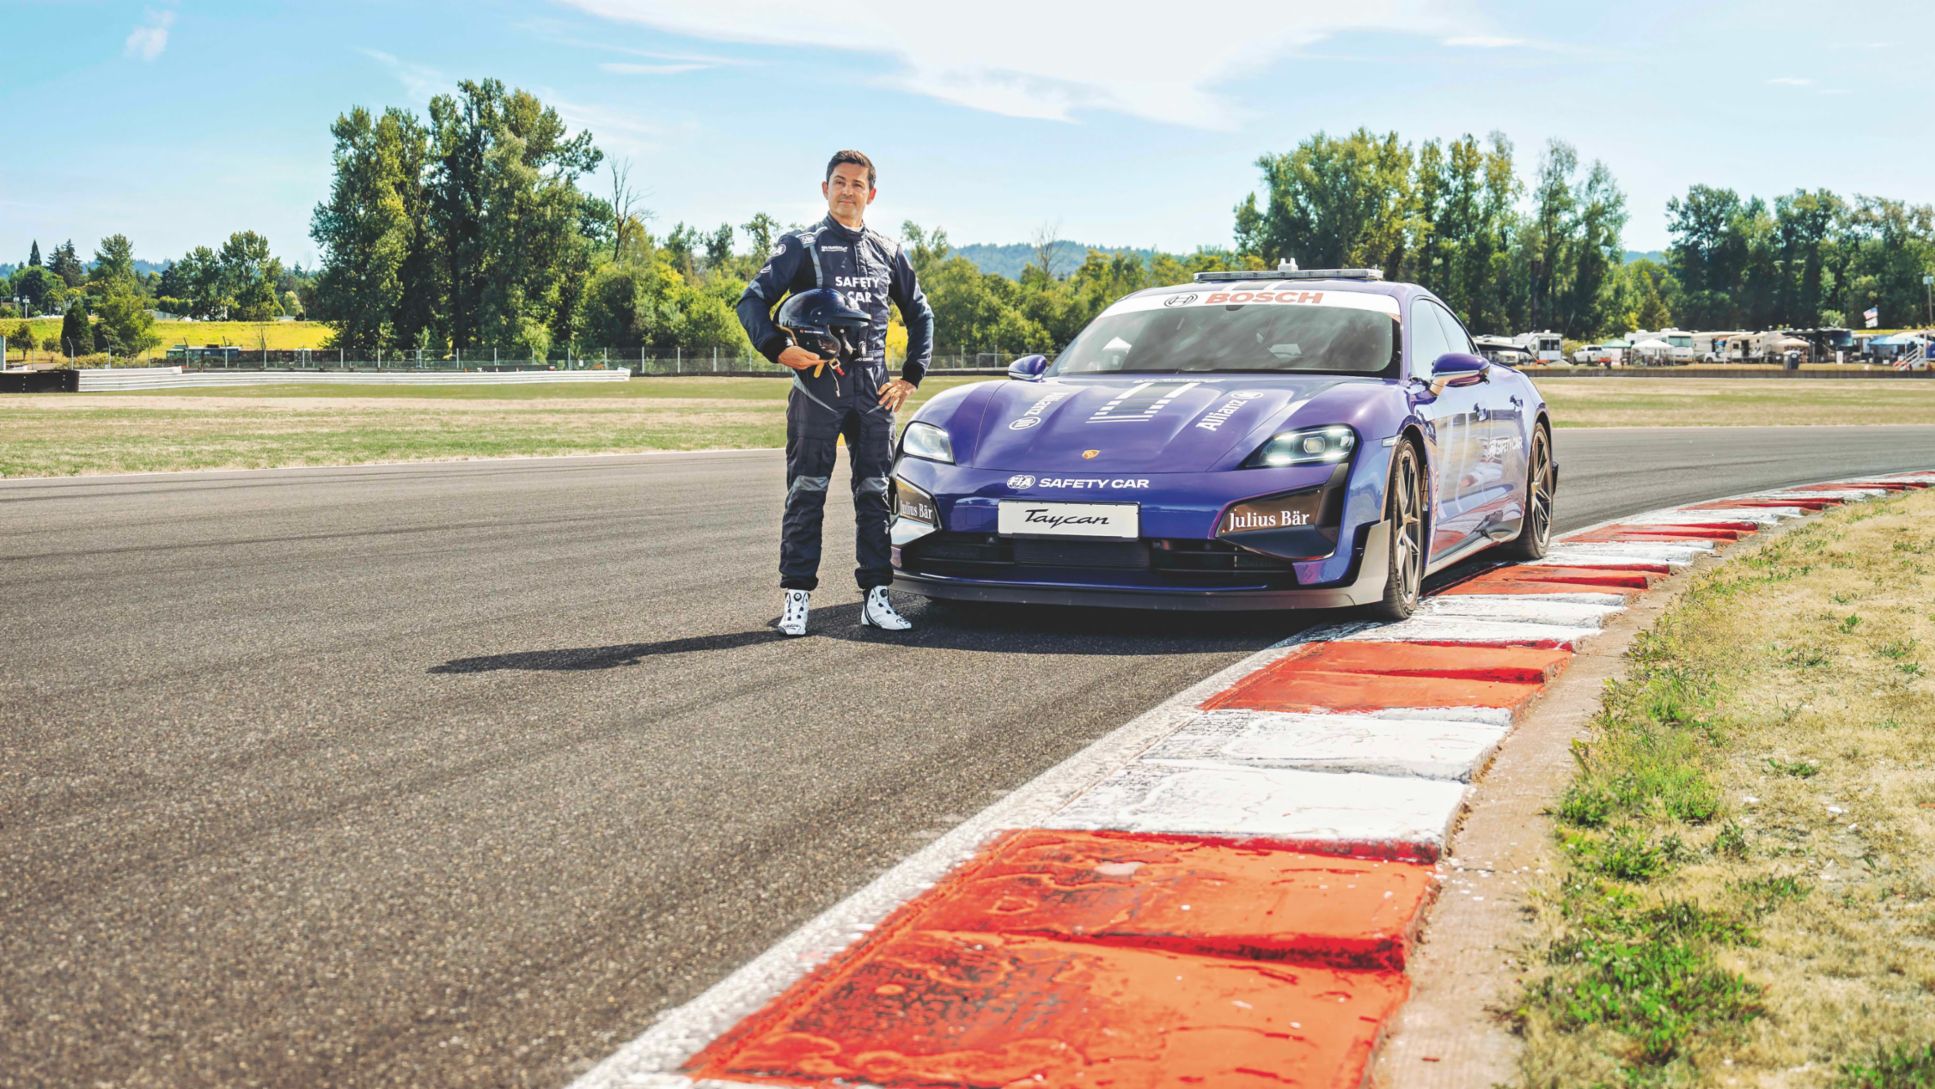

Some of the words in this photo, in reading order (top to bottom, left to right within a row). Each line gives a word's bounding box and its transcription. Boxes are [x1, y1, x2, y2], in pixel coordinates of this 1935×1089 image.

[835, 276, 879, 288] SAFETY
[847, 291, 872, 303] CAR
[1205, 292, 1324, 305] BOSCH
[1195, 399, 1248, 431] Allianz
[1007, 475, 1035, 489] FIA
[1038, 478, 1109, 489] SAFETY
[1111, 479, 1150, 489] CAR
[1024, 509, 1109, 529] Taycan
[1229, 512, 1276, 532] Julius
[1280, 510, 1310, 526] Bär
